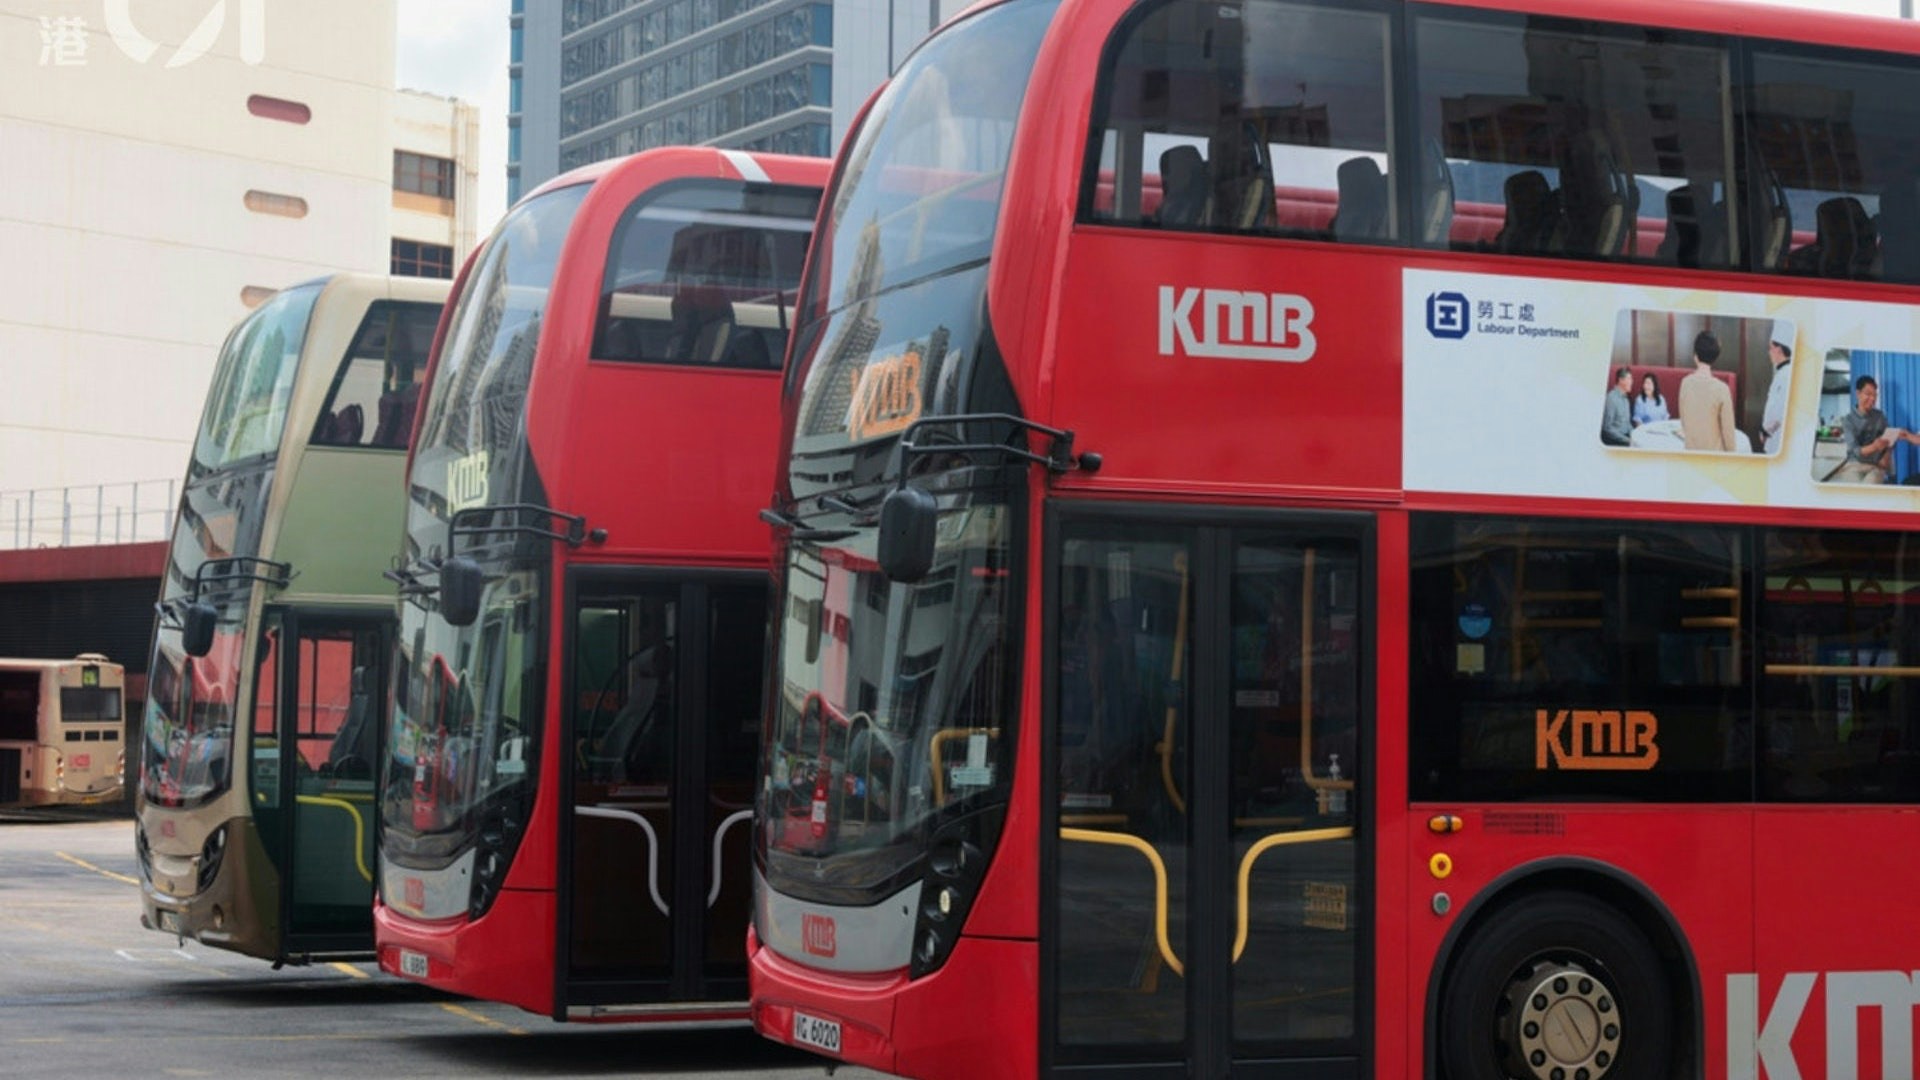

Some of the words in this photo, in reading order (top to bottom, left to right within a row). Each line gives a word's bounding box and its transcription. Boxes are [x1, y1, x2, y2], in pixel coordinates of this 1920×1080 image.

[1158, 285, 1317, 363] KMB
[1477, 301, 1535, 322] 勞工處
[1477, 323, 1515, 336] Labour
[1518, 325, 1580, 339] Department
[848, 351, 922, 443] KMB
[447, 450, 489, 518] KMB
[1536, 709, 1659, 770] KMB
[802, 912, 837, 958] KMB
[811, 1019, 840, 1048] 6020
